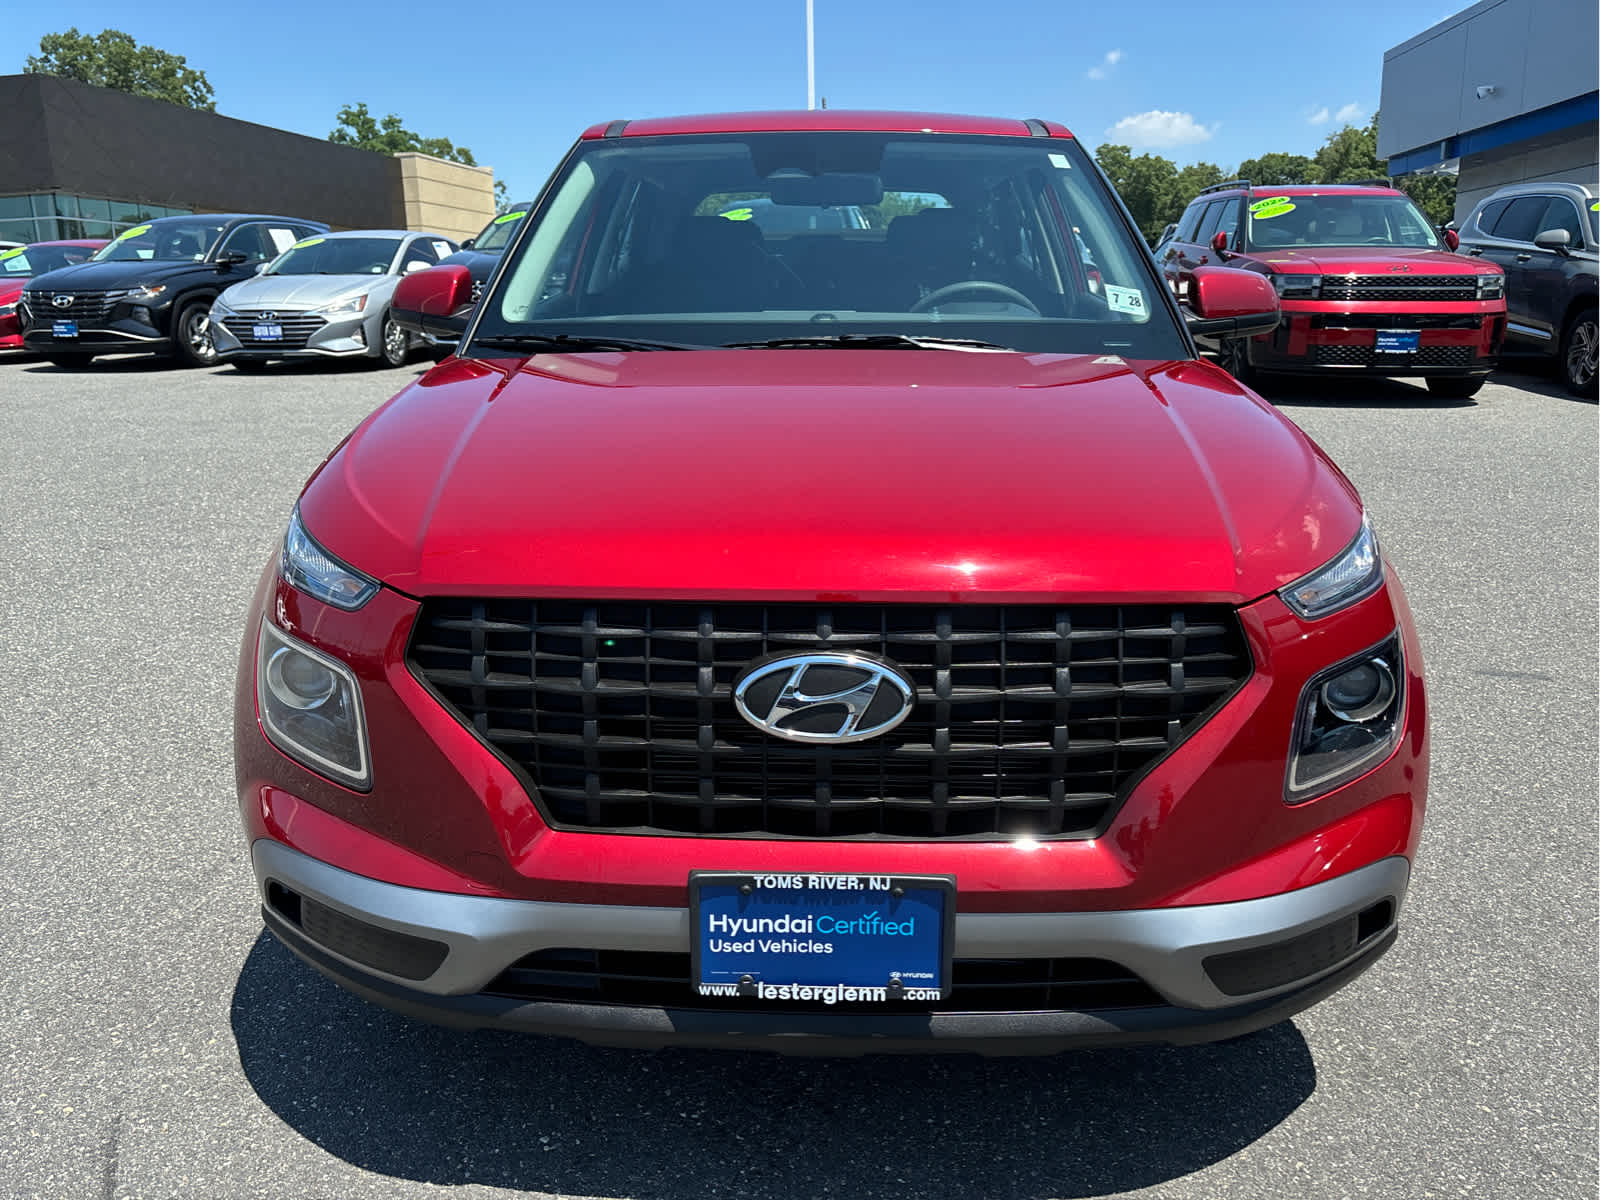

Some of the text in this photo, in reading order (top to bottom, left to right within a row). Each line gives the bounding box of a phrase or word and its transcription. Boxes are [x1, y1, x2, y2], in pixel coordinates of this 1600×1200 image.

[1112, 293, 1142, 307] 7 28
[753, 876, 891, 891] TOMS RIVER, NJ
[709, 911, 915, 937] Hyundai Certified
[709, 939, 833, 954] Used Vehicles
[698, 981, 940, 1004] www. lesterglenn .com
